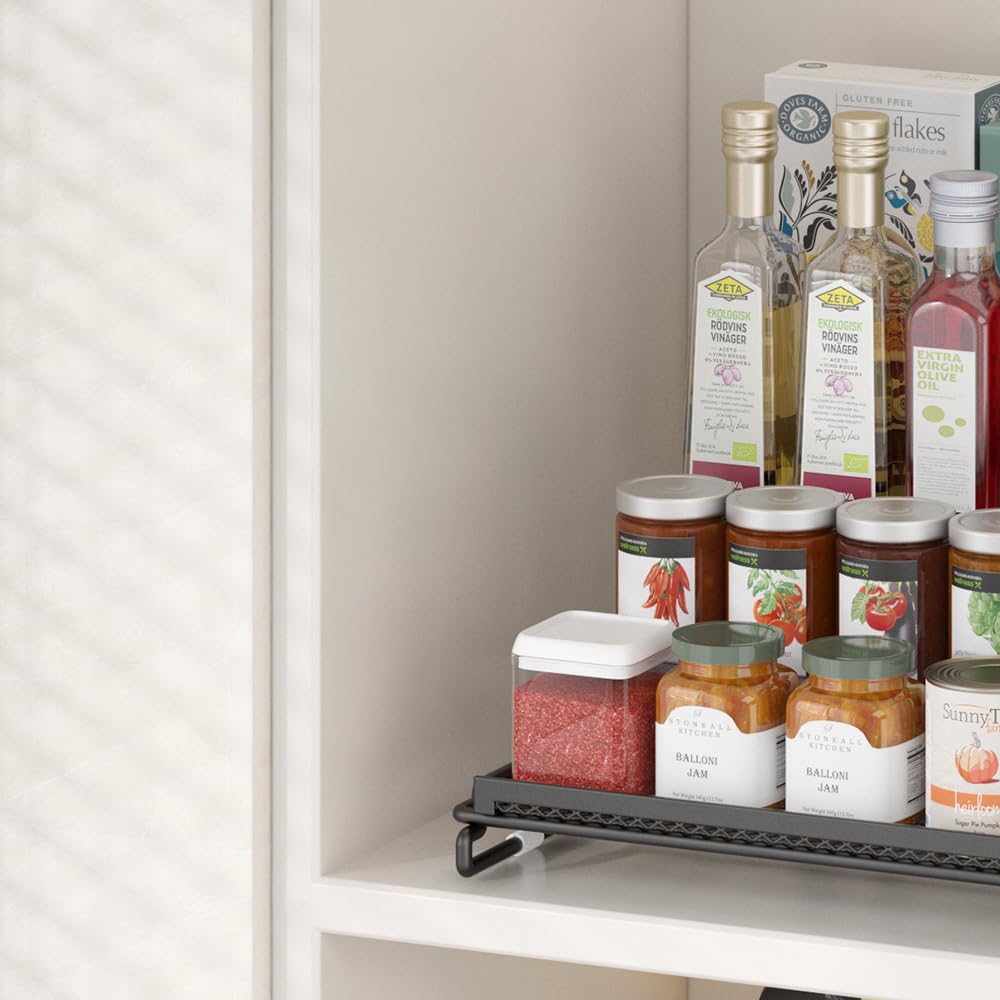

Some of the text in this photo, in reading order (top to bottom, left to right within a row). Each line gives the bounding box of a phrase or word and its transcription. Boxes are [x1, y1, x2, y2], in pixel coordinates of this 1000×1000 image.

[842, 94, 913, 107] GLUTEN FREE
[780, 96, 828, 122] DOVES FARM
[783, 123, 826, 142] ORGANIC
[892, 116, 946, 142] flakes
[716, 283, 743, 294] ZETA
[827, 293, 854, 304] ZETA
[707, 307, 751, 321] EKOLOGISK
[711, 318, 747, 333] RÖDVINS
[818, 318, 863, 332] EKOLOGISK
[711, 331, 747, 345] VINÄGER
[822, 329, 859, 344] RÖDVINS
[822, 342, 858, 355] VINÄGER
[917, 350, 962, 363] EXTRA
[917, 360, 964, 373] VIRGIN
[917, 370, 957, 382] OLIVE
[917, 380, 939, 391] OIL
[678, 727, 721, 738] KITCHEN
[809, 742, 851, 753] KITCHEN
[675, 752, 718, 766] BALLONI
[686, 768, 708, 779] JAM
[806, 766, 849, 781] BALLONI
[817, 783, 839, 794] JAM
